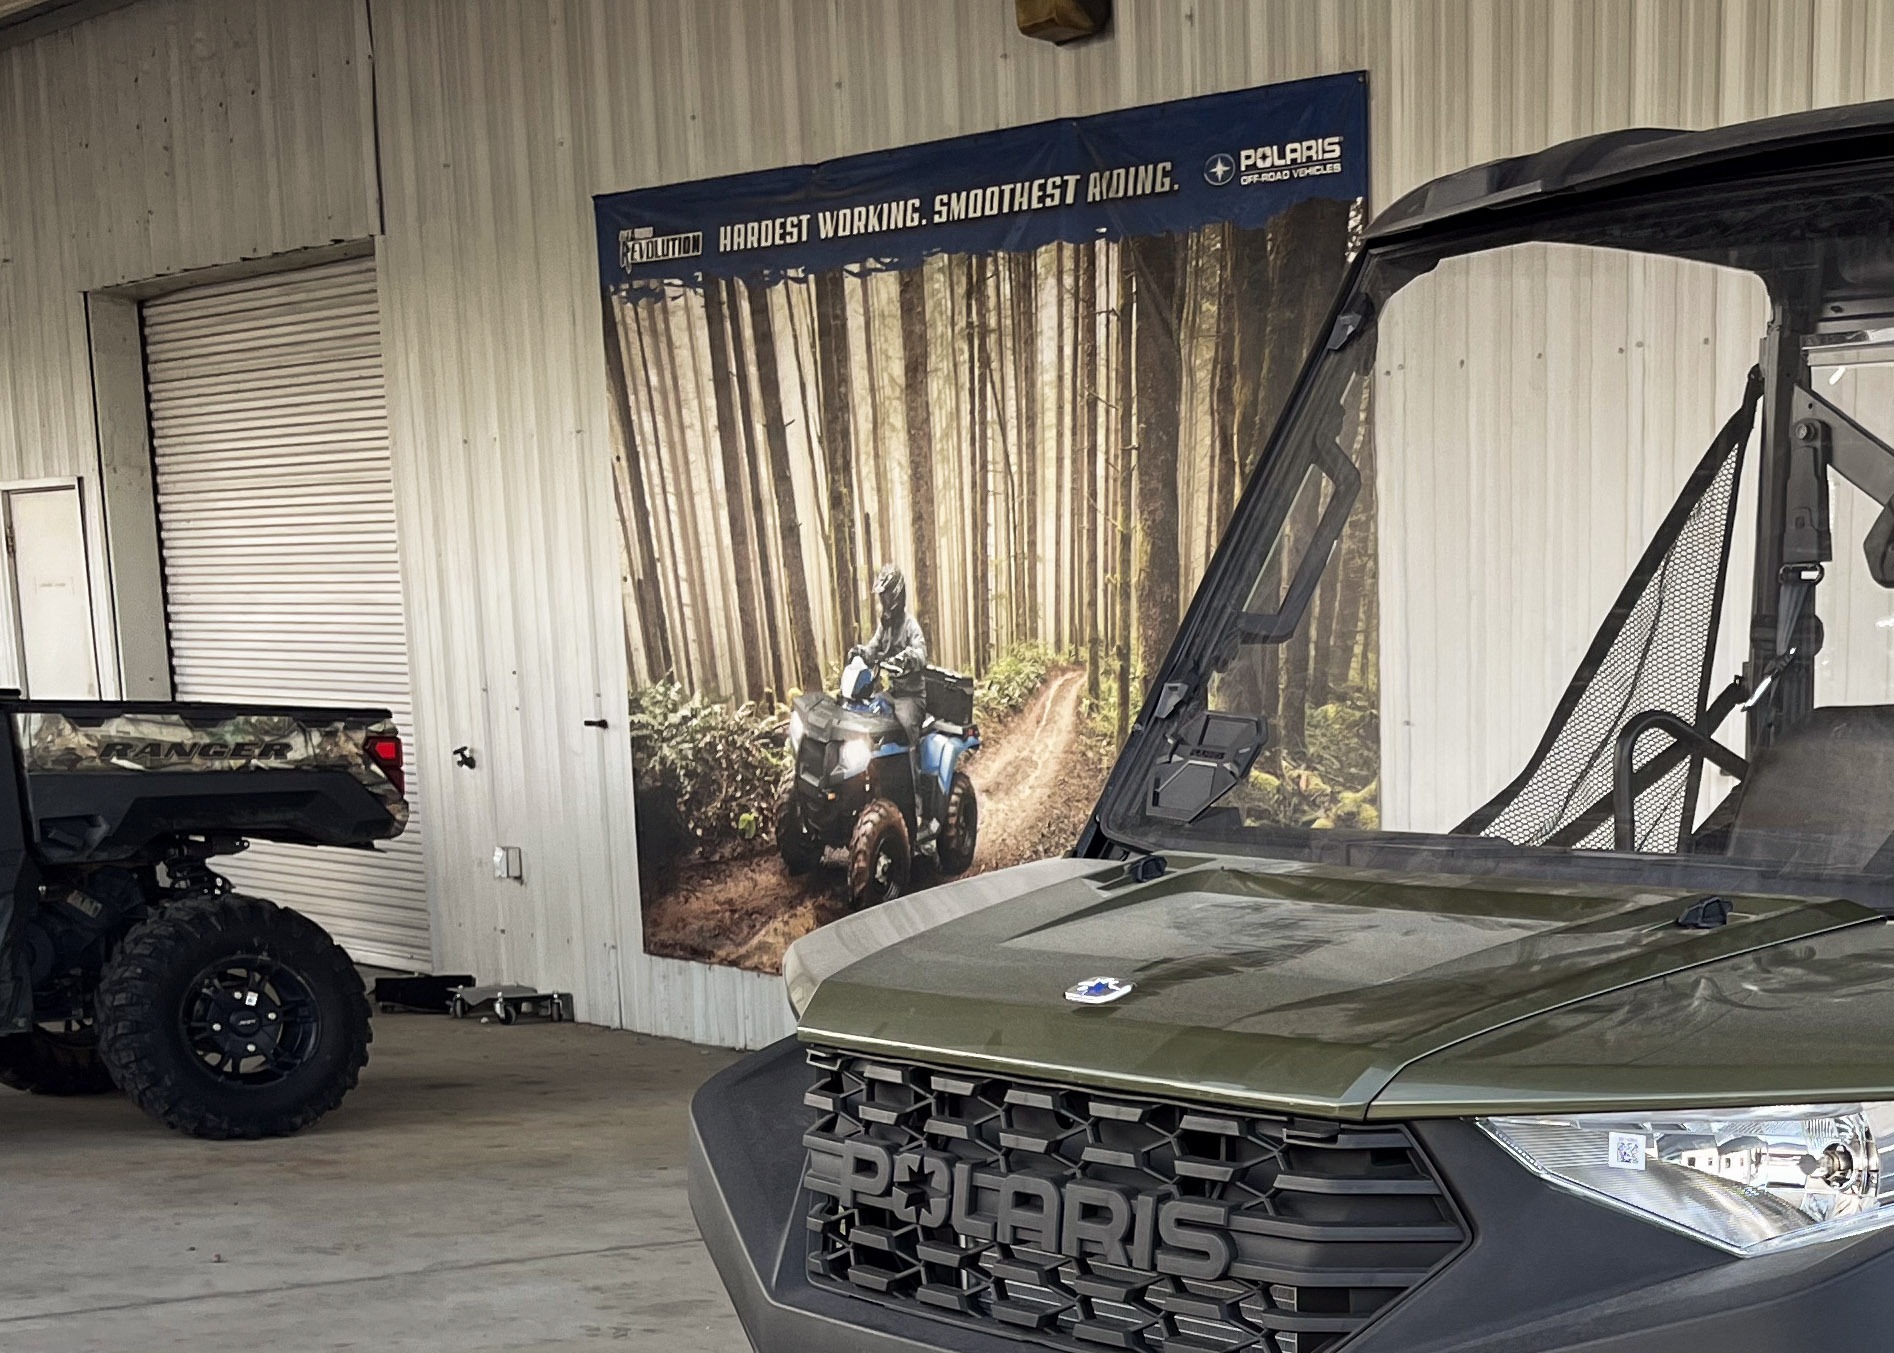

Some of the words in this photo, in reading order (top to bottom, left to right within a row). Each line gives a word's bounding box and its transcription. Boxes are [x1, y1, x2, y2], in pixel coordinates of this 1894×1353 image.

[1241, 137, 1341, 171] POLARIS
[1241, 170, 1290, 186] OFF-ROAD
[1292, 163, 1341, 178] VEHICLES
[719, 214, 811, 252] HARDEST
[818, 198, 927, 240] WORKING.
[933, 174, 1081, 224] SMOOTHEST
[620, 231, 702, 274] REVOLUTION
[99, 742, 294, 760] RANGER
[839, 1139, 1238, 1281] POLARIS
